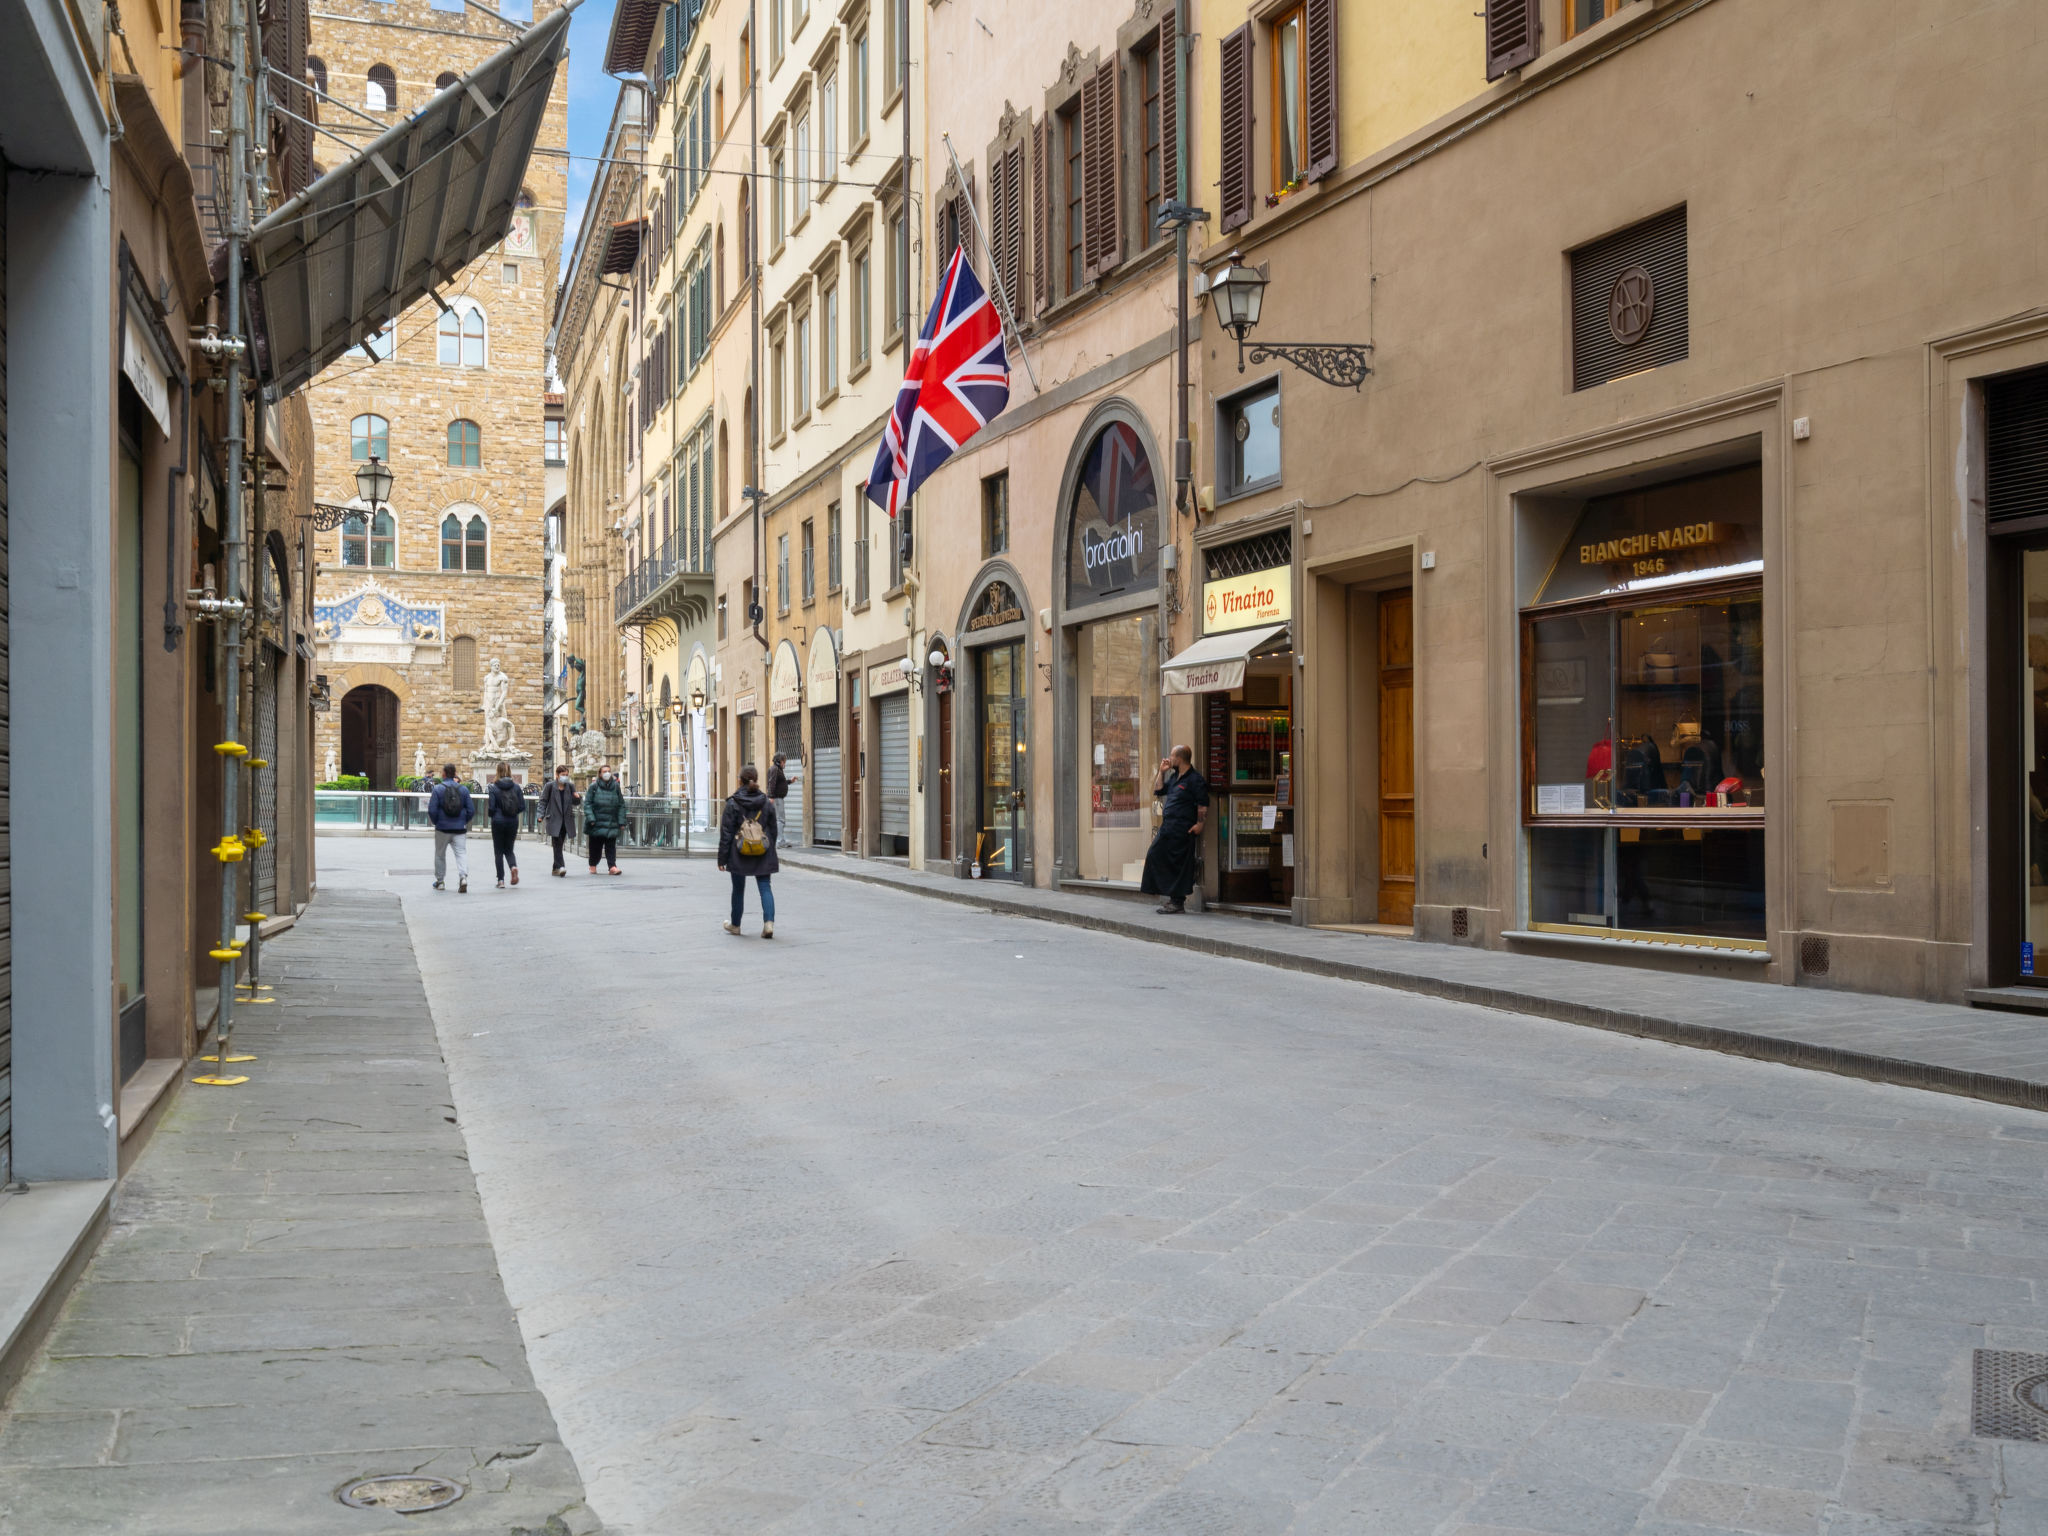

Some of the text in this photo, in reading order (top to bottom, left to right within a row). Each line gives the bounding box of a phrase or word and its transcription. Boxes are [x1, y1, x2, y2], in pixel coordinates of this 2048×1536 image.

[1085, 512, 1143, 569] braccialini
[1580, 521, 1714, 564] BIANCHI E NARDI
[1633, 558, 1665, 577] 1946
[1222, 586, 1274, 614] Vinaino
[1256, 608, 1280, 619] Fiorenza
[1186, 670, 1219, 688] Vinaino
